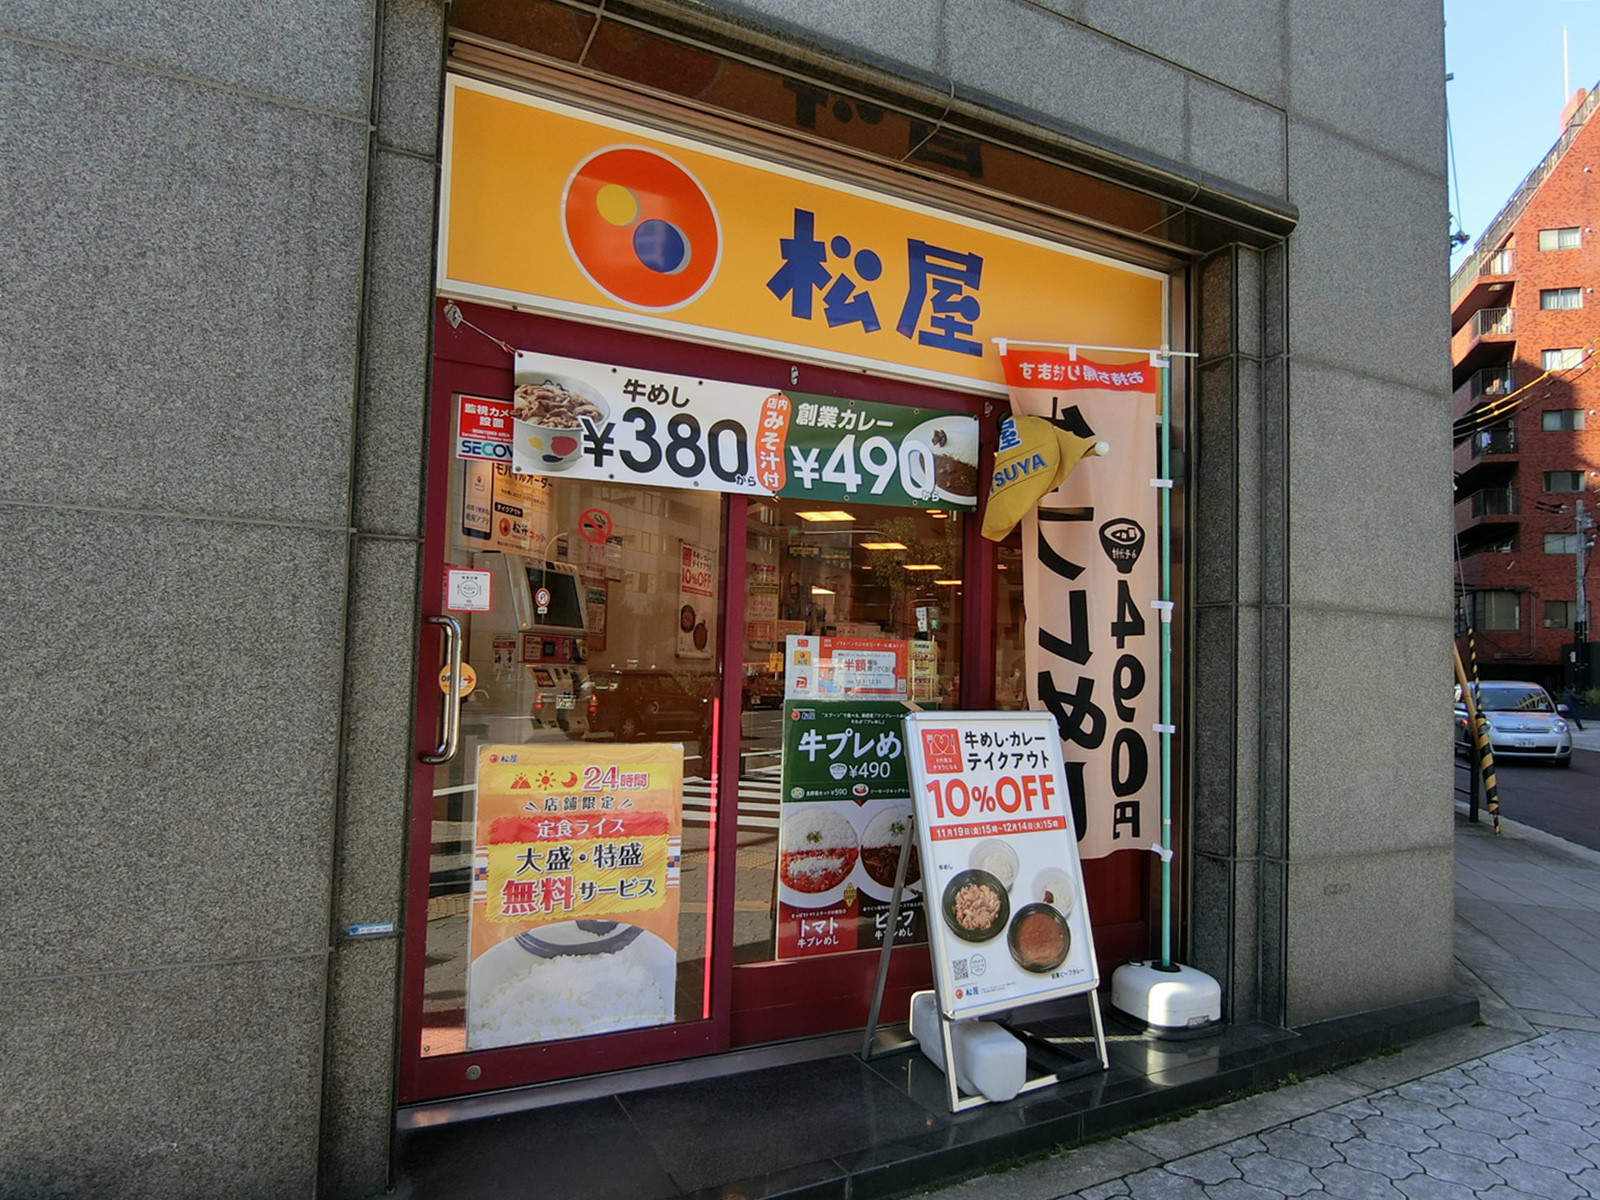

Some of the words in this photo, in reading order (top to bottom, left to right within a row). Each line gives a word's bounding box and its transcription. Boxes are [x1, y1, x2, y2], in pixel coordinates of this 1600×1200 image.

[766, 208, 984, 357] 松屋
[622, 379, 690, 408] 牛めし
[766, 397, 789, 410] 店内
[479, 418, 505, 429] 設置
[796, 403, 894, 431] 創業カレー
[580, 407, 749, 483] ¥380
[760, 411, 785, 488] みそ汁付
[790, 434, 936, 499] ¥490
[845, 659, 866, 672] 半額
[965, 731, 1047, 749] 牛めし・カレー
[500, 755, 518, 763] 松屋
[849, 762, 890, 778] ¥490
[967, 750, 1050, 772] テイクアウト
[582, 766, 648, 790] 24時間
[544, 796, 615, 812] 店舗限定
[926, 774, 1055, 818] 10%OFF
[537, 817, 625, 839] 定食ライス
[516, 842, 642, 875] 大盛・特盛
[801, 917, 839, 937] トマト
[797, 936, 839, 948] 牛プレめし
